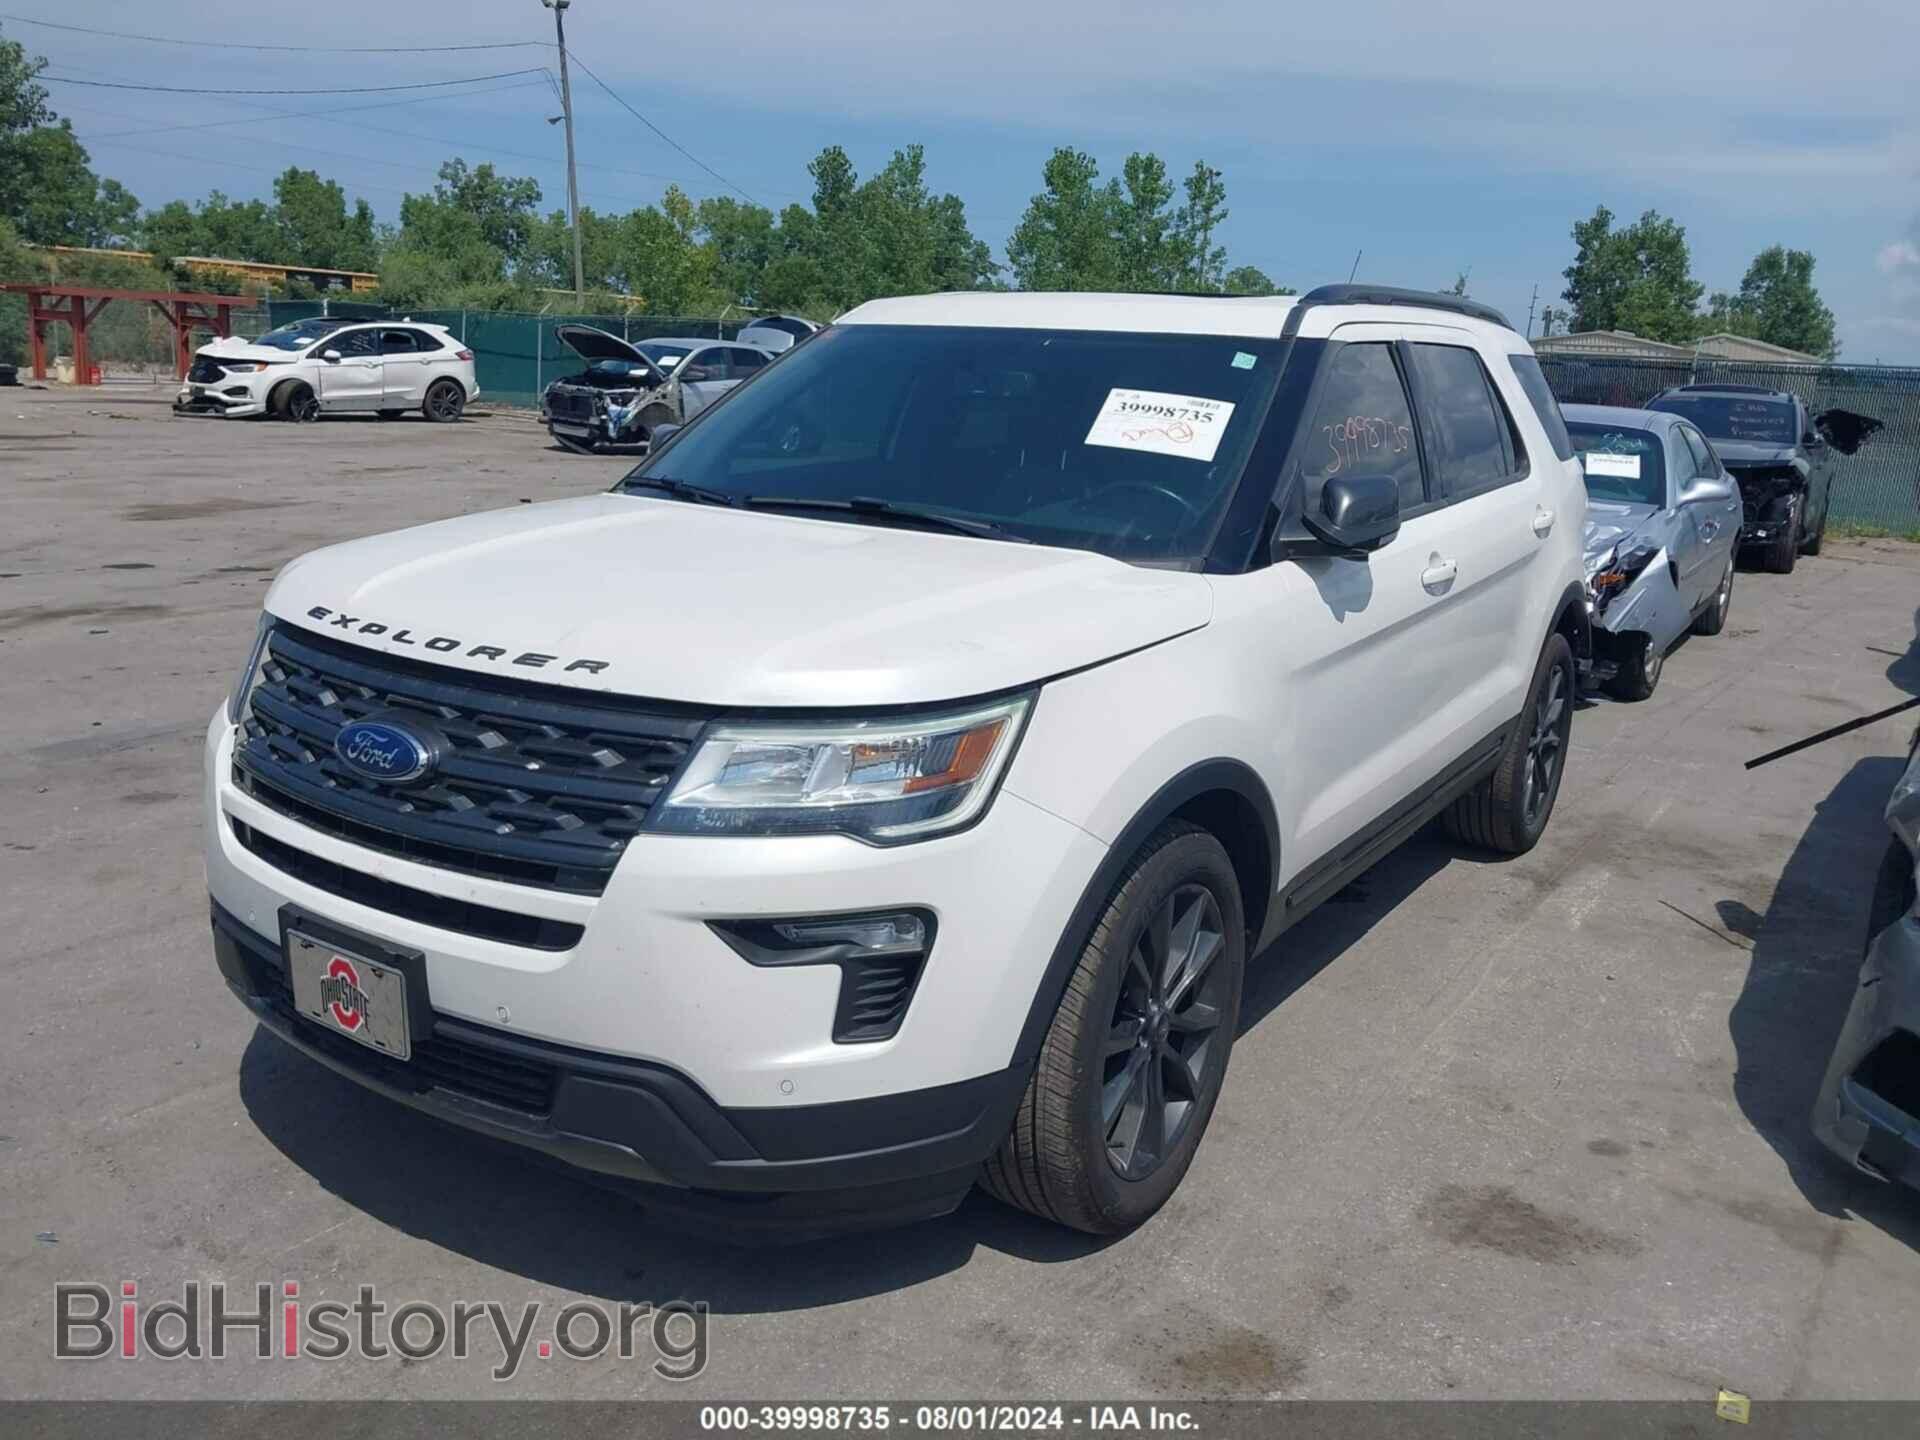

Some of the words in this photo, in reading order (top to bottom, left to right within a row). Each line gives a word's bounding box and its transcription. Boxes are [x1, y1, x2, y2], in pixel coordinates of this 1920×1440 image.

[1114, 400, 1216, 425] 39998735
[307, 606, 611, 674] EXPLORER
[346, 729, 401, 770] Ford
